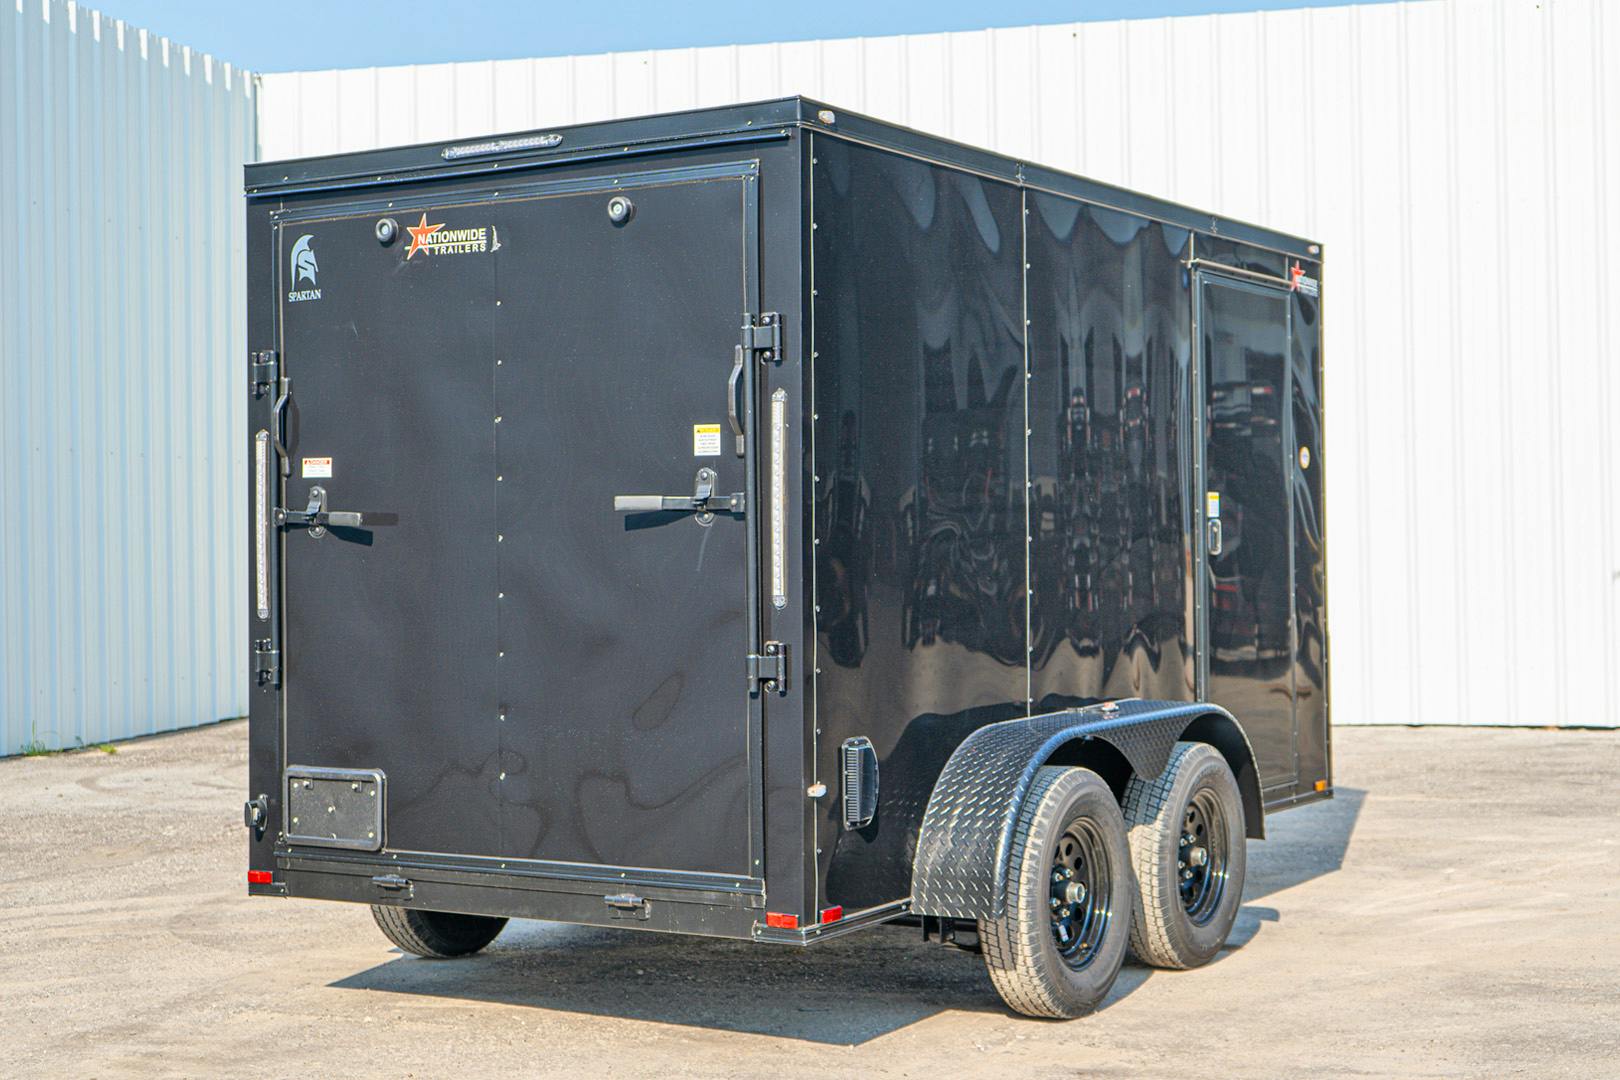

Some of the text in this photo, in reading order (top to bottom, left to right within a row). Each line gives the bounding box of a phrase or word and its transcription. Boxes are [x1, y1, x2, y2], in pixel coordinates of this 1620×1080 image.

[417, 228, 487, 245] NATIONWIDE
[434, 244, 487, 255] TRAILERS
[288, 289, 322, 302] SPARTAN
